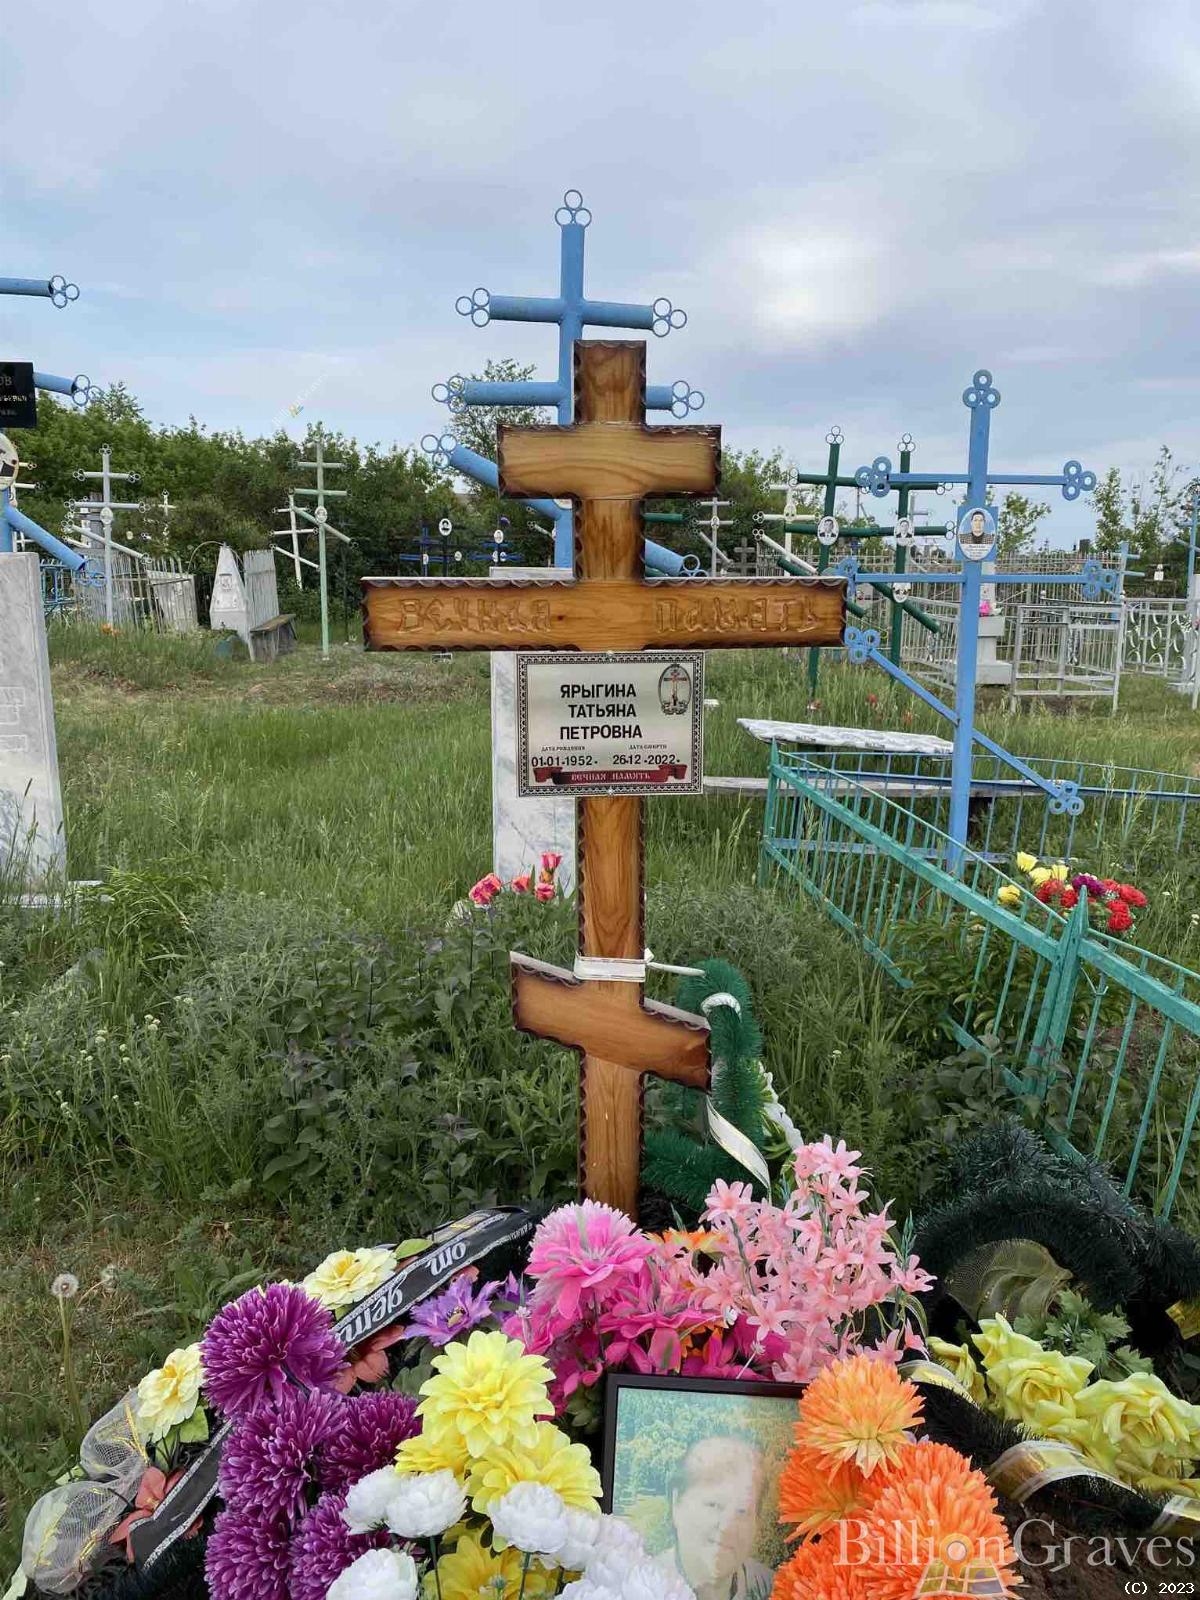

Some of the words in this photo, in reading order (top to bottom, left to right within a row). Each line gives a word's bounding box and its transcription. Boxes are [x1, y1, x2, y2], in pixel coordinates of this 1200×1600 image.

[560, 683, 637, 698] ЯРЫГИНА
[568, 703, 637, 718] ТАТЬЯНА
[560, 725, 643, 740] ПЕТРОВНА
